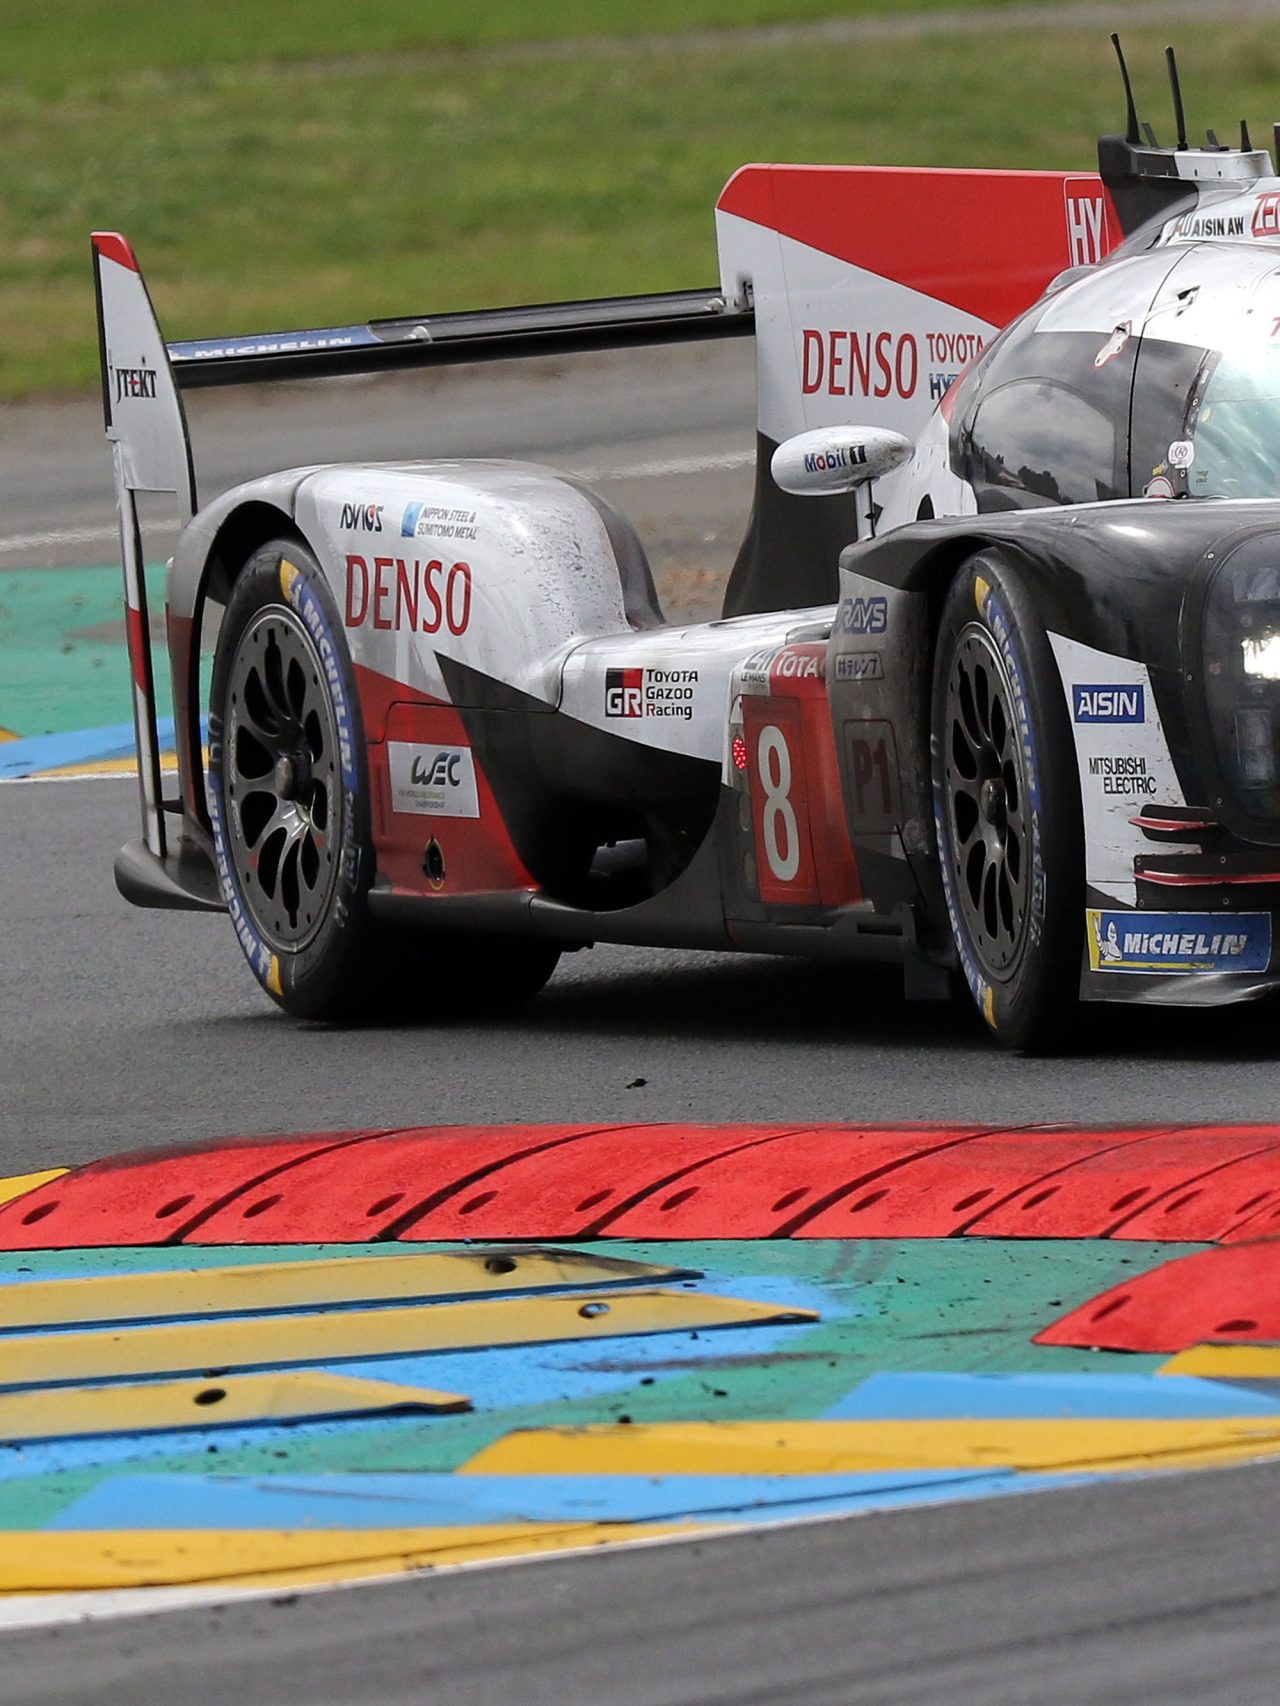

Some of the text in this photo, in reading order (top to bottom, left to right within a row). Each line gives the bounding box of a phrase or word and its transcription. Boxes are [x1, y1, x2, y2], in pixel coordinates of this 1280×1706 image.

[1068, 199, 1102, 267] HY
[1191, 216, 1244, 236] AISIN AW
[194, 336, 351, 357] MICHELIN
[802, 330, 918, 400] DENSO
[115, 368, 157, 403] JTEKT
[804, 448, 847, 472] Mobil
[422, 507, 448, 519] NIPPON
[448, 510, 470, 522] STEEL
[417, 523, 477, 540] SUMITOMO METAL
[345, 555, 472, 636] DENSO
[646, 669, 698, 682] TOYOTA
[776, 651, 826, 678] TOTA
[302, 600, 353, 773] MICHELIN
[646, 687, 692, 700] GAZOO
[606, 687, 642, 716] GR
[646, 702, 692, 720] Racing
[1078, 692, 1137, 716] AISIN
[411, 752, 461, 787] WEC
[852, 738, 892, 815] P1
[1089, 757, 1146, 775] MITSUBISHI
[1104, 776, 1157, 794] ELECTRIC
[758, 725, 799, 881] 8
[1123, 932, 1248, 956] MICHELIN
